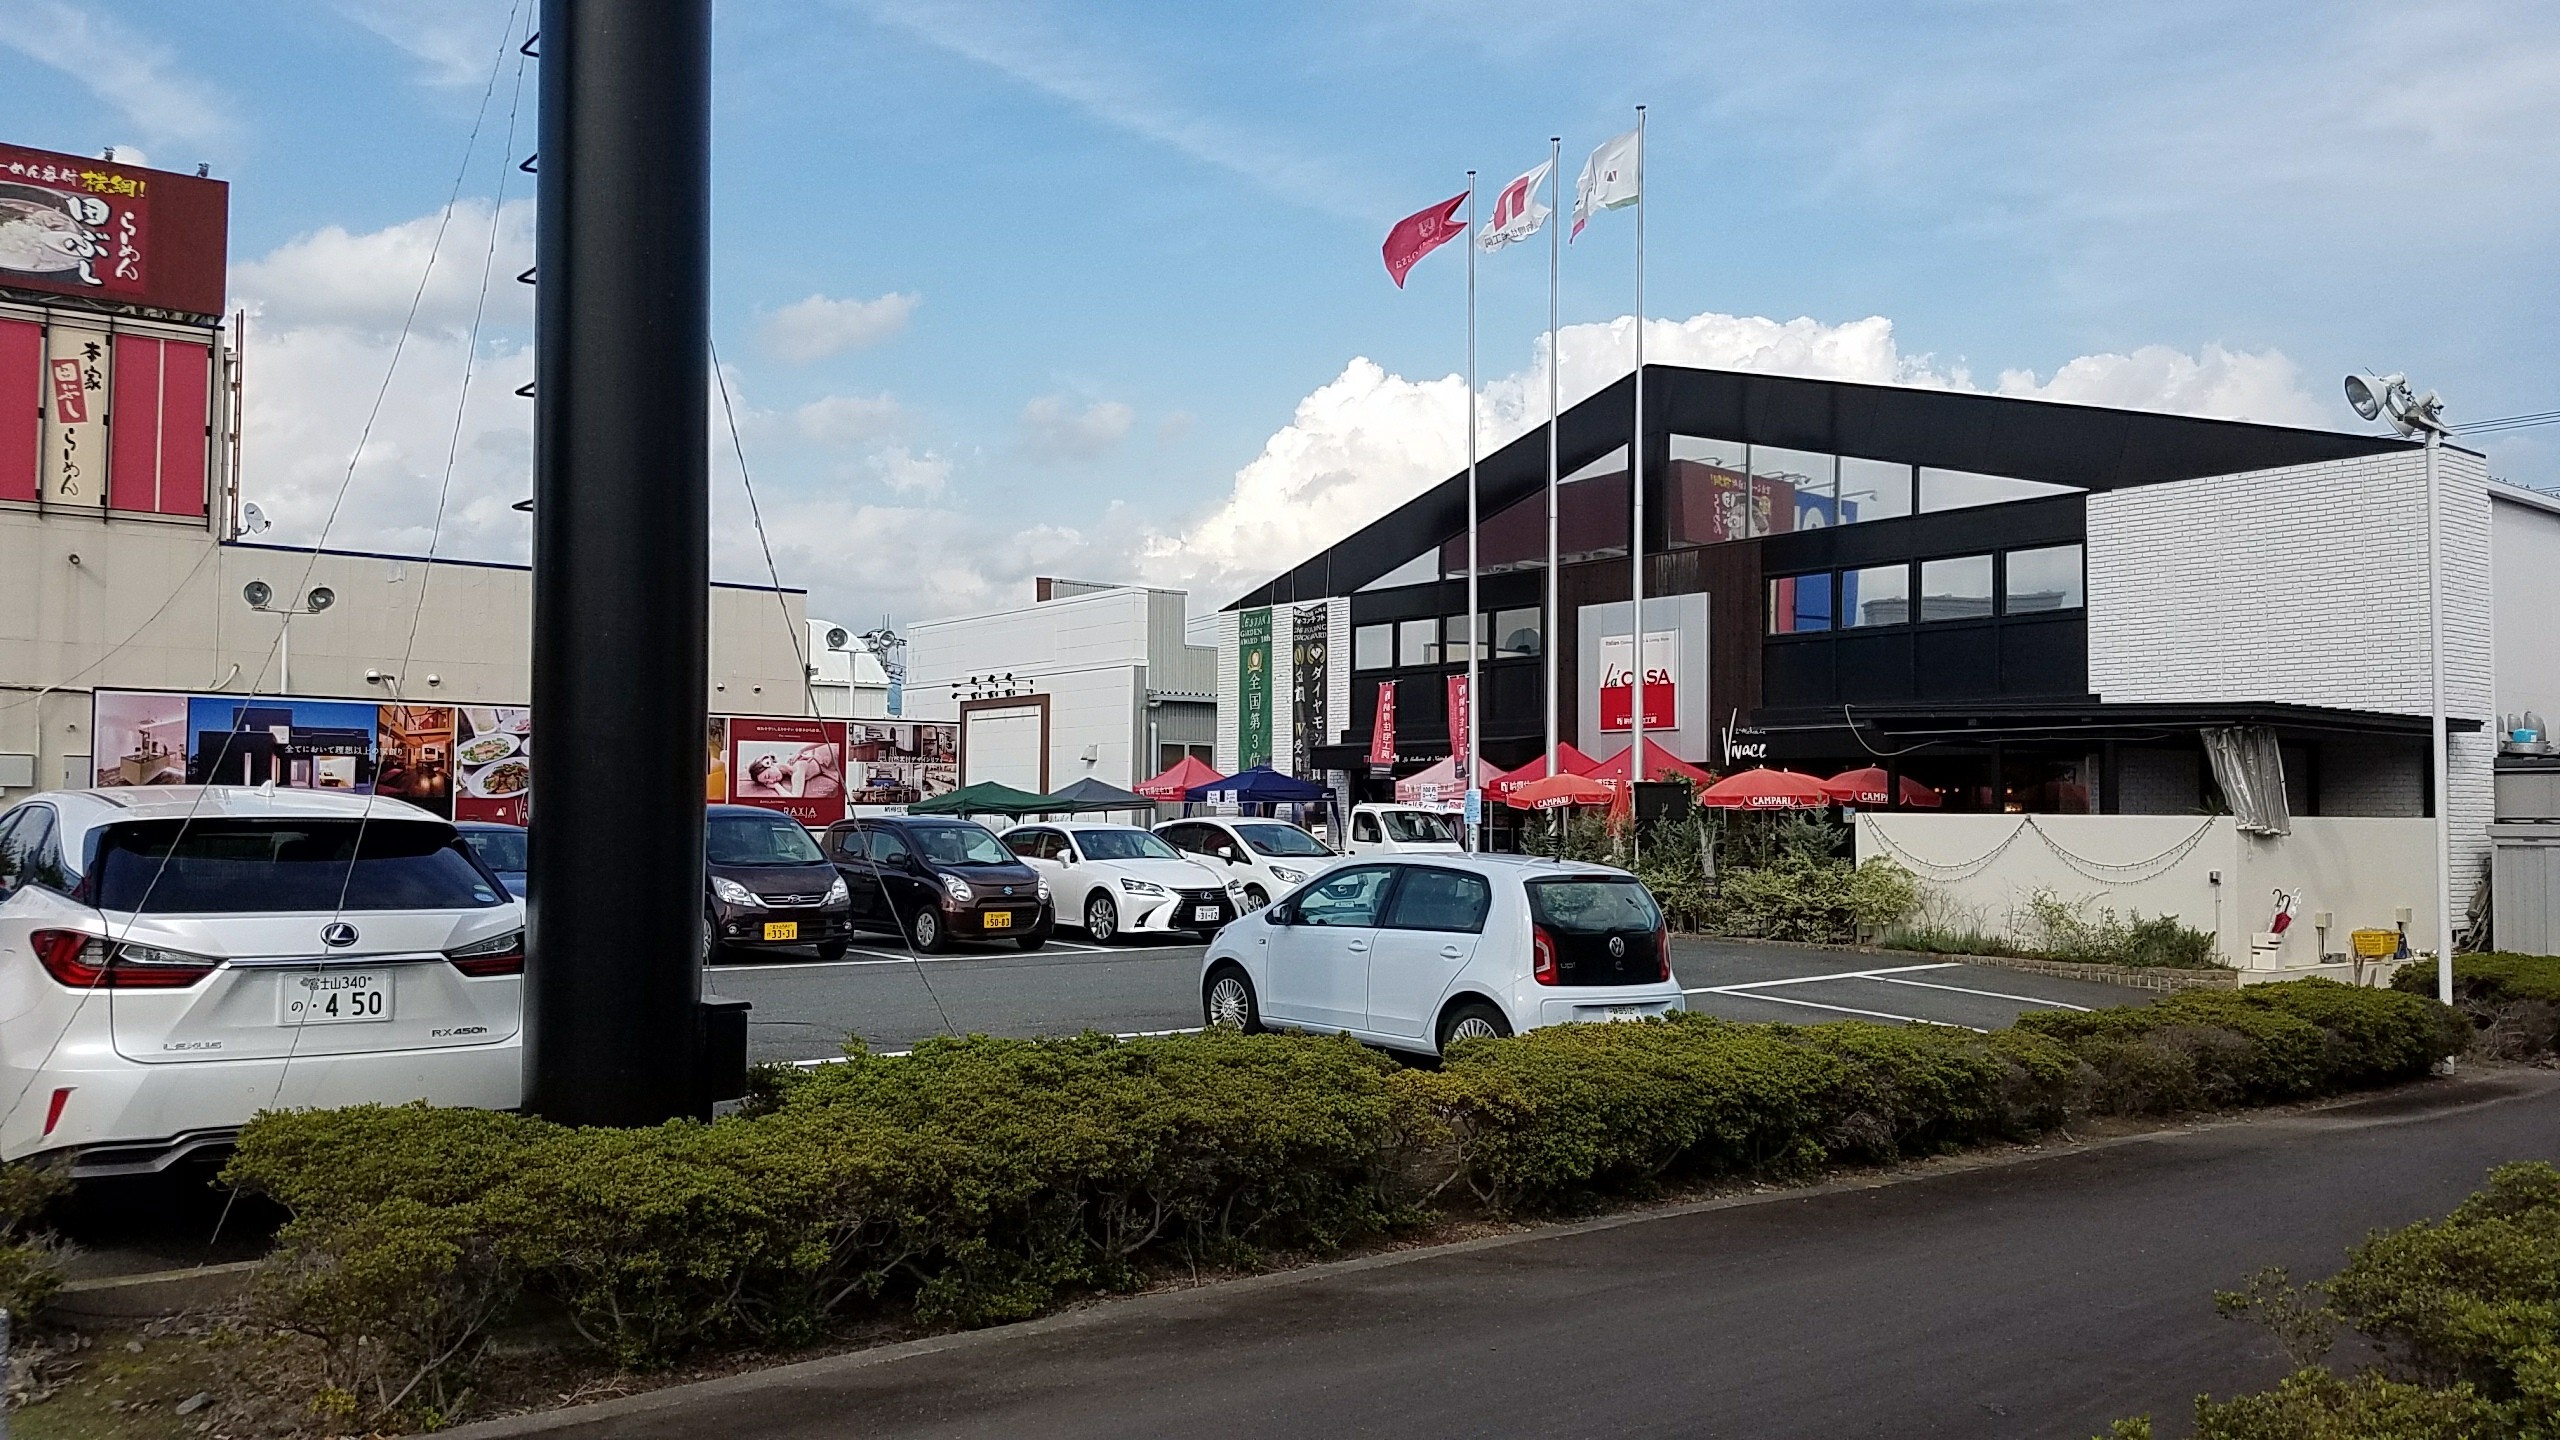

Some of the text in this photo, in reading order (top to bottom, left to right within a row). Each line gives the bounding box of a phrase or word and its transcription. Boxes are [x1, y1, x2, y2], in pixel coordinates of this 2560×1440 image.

[115, 211, 140, 280] らーめん
[80, 342, 102, 390] 本家
[60, 427, 80, 496] らーめん
[1621, 668, 1671, 687] CSA
[1722, 707, 1767, 766] Vivace
[1537, 795, 1569, 808] CAMPARI
[1752, 795, 1791, 806] CAMPARI
[291, 1001, 304, 1013] の
[163, 1041, 223, 1051] LEXUS
